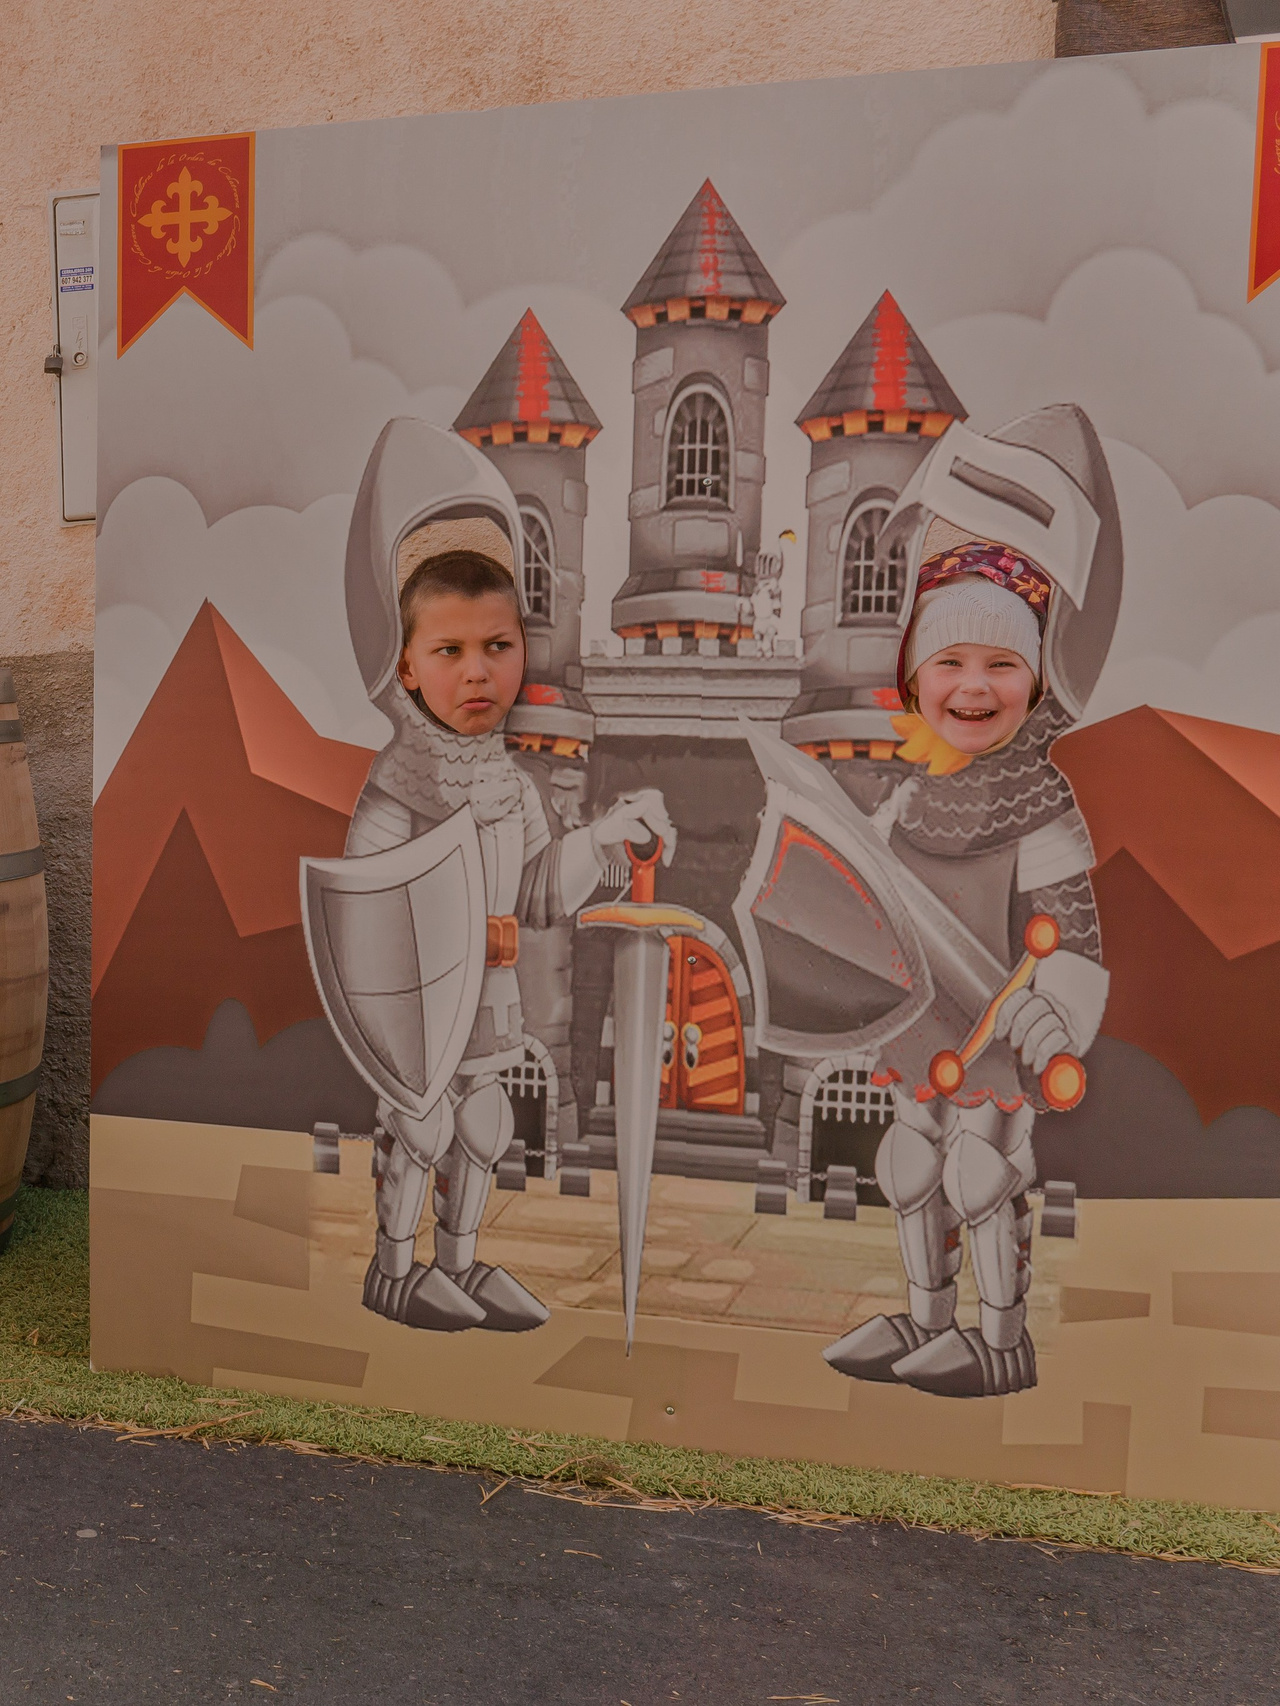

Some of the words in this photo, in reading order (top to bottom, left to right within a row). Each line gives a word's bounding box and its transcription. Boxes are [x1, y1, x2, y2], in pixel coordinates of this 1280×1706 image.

[62, 277, 71, 285] 607
[72, 276, 82, 284] 942
[83, 275, 93, 283] 377
